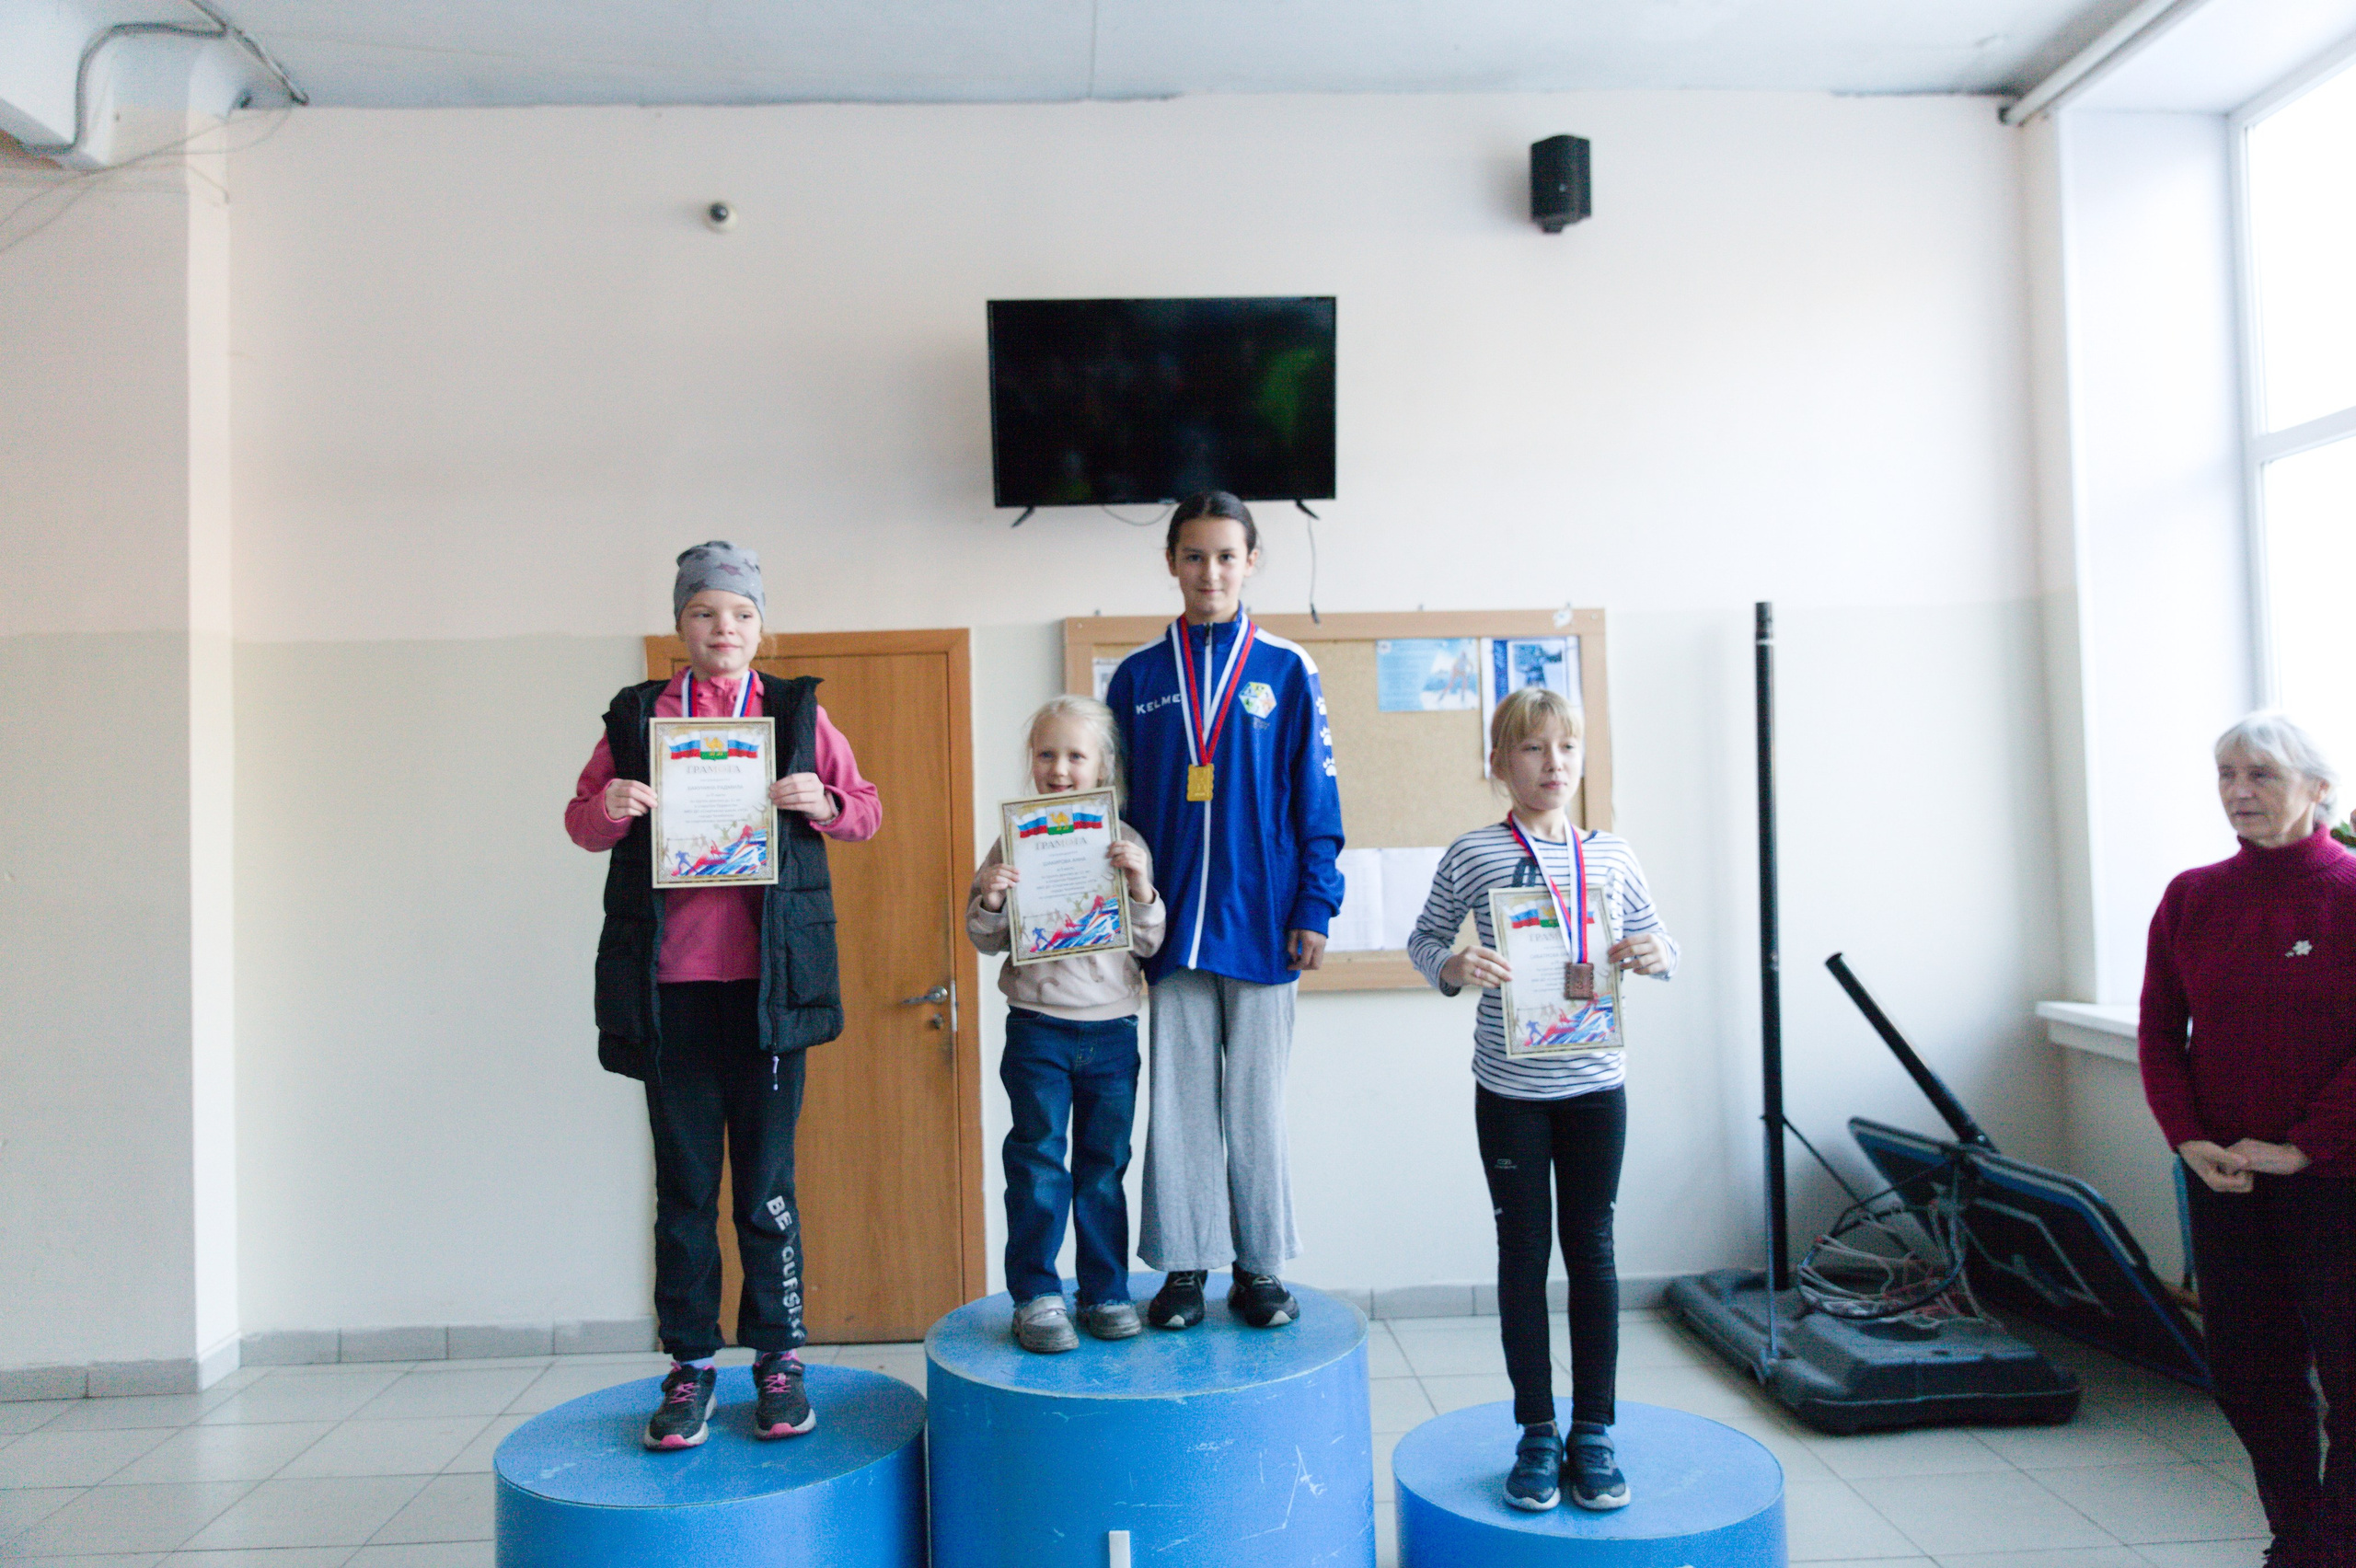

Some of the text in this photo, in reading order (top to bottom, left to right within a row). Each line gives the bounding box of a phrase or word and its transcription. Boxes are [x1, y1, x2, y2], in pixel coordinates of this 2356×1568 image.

[1136, 694, 1181, 714] KELME
[687, 765, 741, 774] ГРАМОТА
[1034, 836, 1088, 850] ГРАМОТА
[766, 1195, 792, 1231] BE
